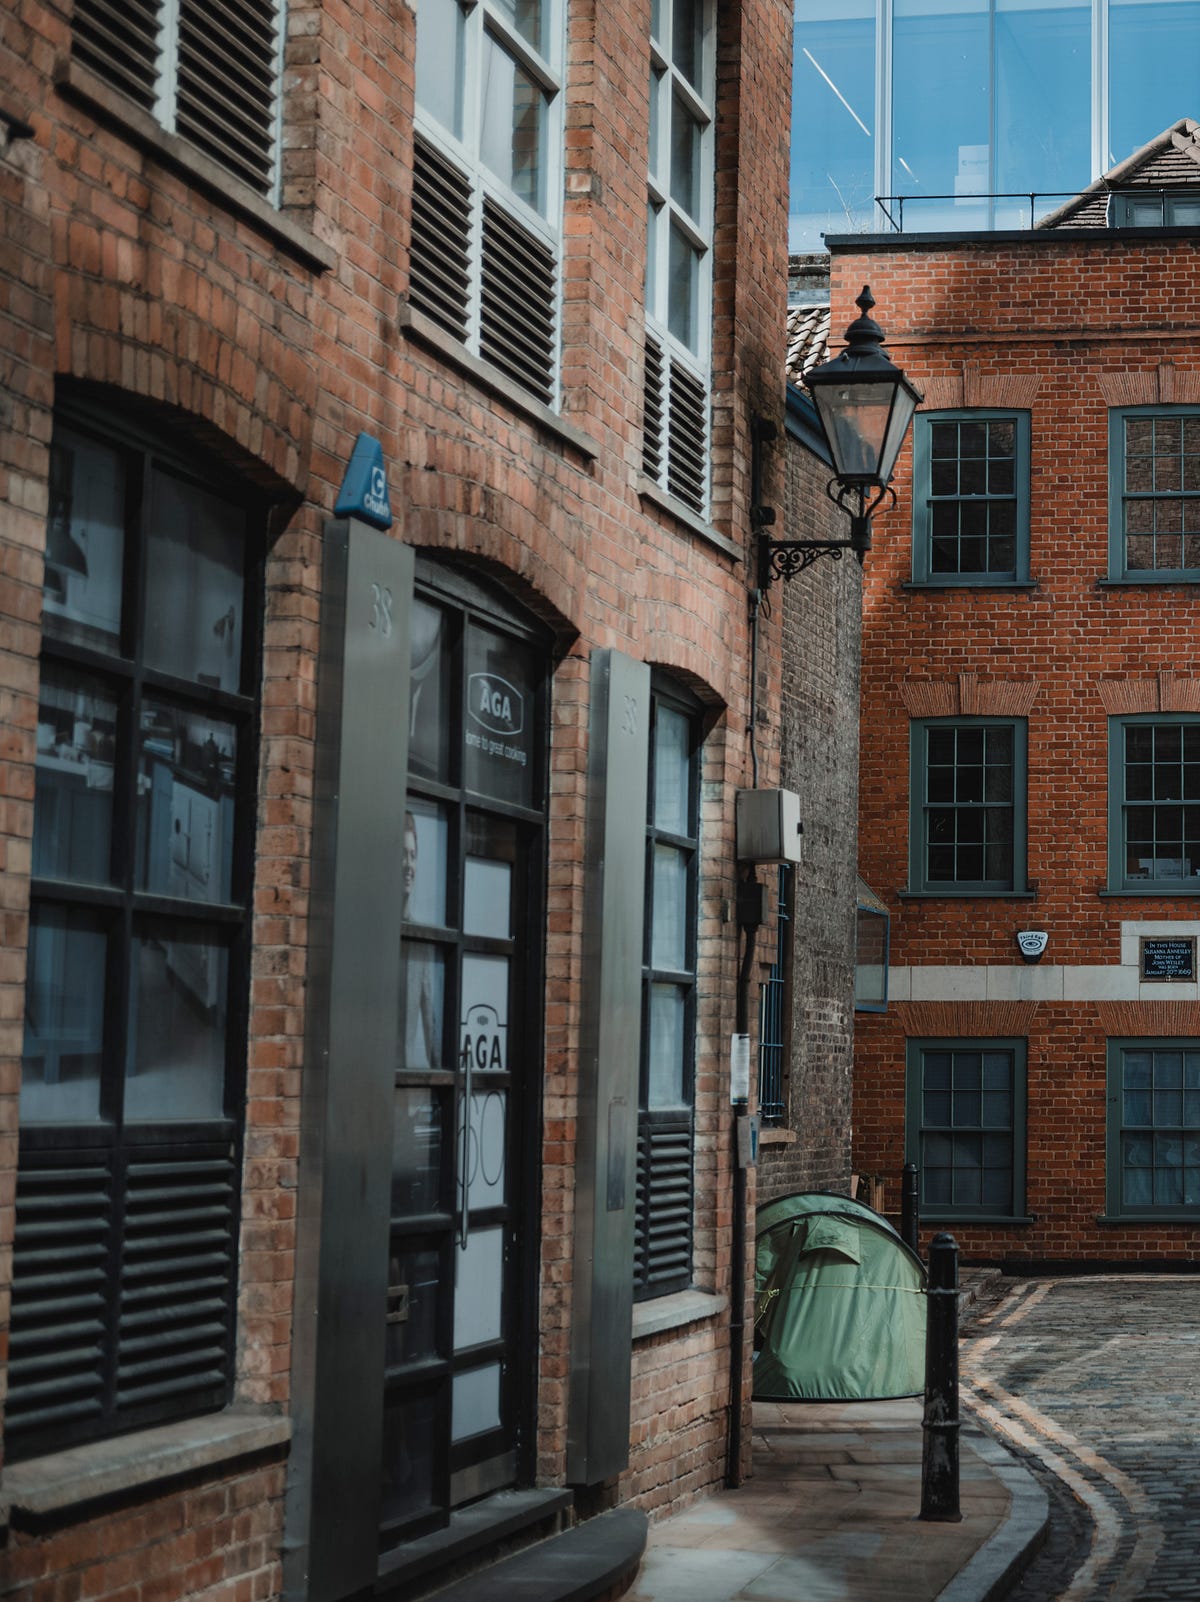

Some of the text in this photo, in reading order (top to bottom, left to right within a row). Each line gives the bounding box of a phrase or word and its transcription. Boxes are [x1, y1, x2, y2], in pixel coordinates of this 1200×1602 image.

[363, 493, 390, 518] Chubb
[480, 687, 511, 721] AGA
[481, 736, 488, 750] to
[489, 740, 504, 756] great
[504, 746, 526, 766] cooking
[461, 1034, 503, 1069] AGA
